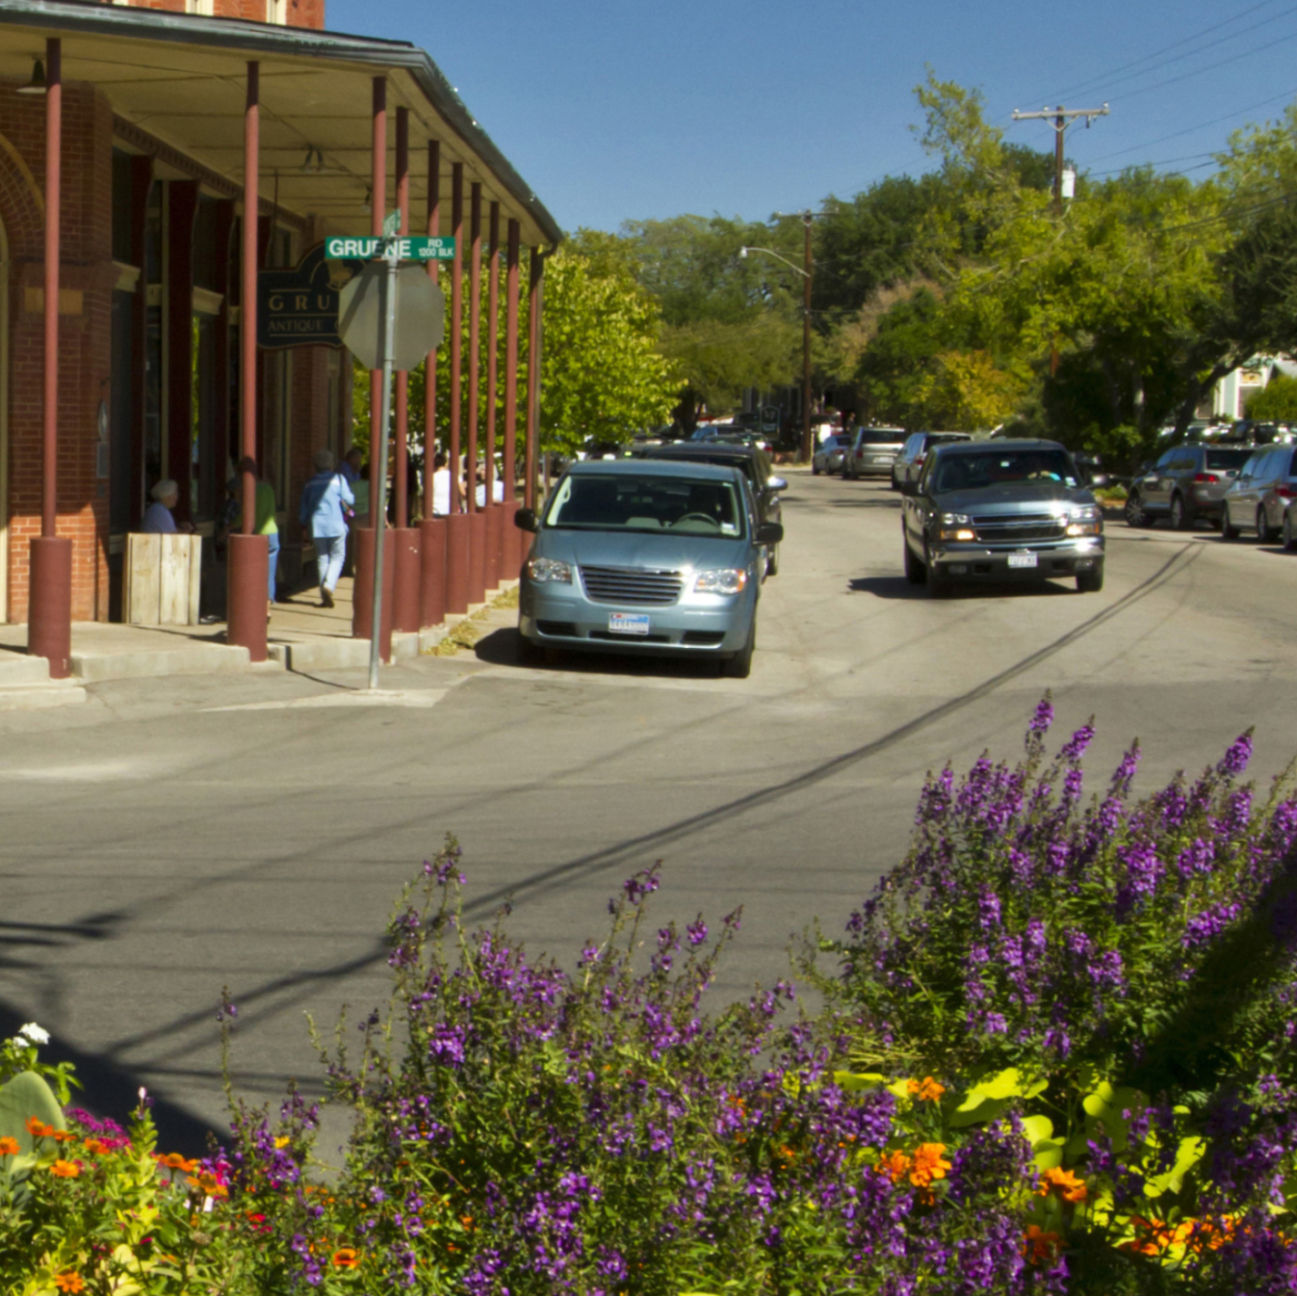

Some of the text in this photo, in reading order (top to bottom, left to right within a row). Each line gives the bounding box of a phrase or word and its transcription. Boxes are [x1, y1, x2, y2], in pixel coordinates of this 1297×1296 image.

[427, 238, 443, 248] RD
[438, 247, 453, 257] BLK
[268, 294, 330, 311] GRU
